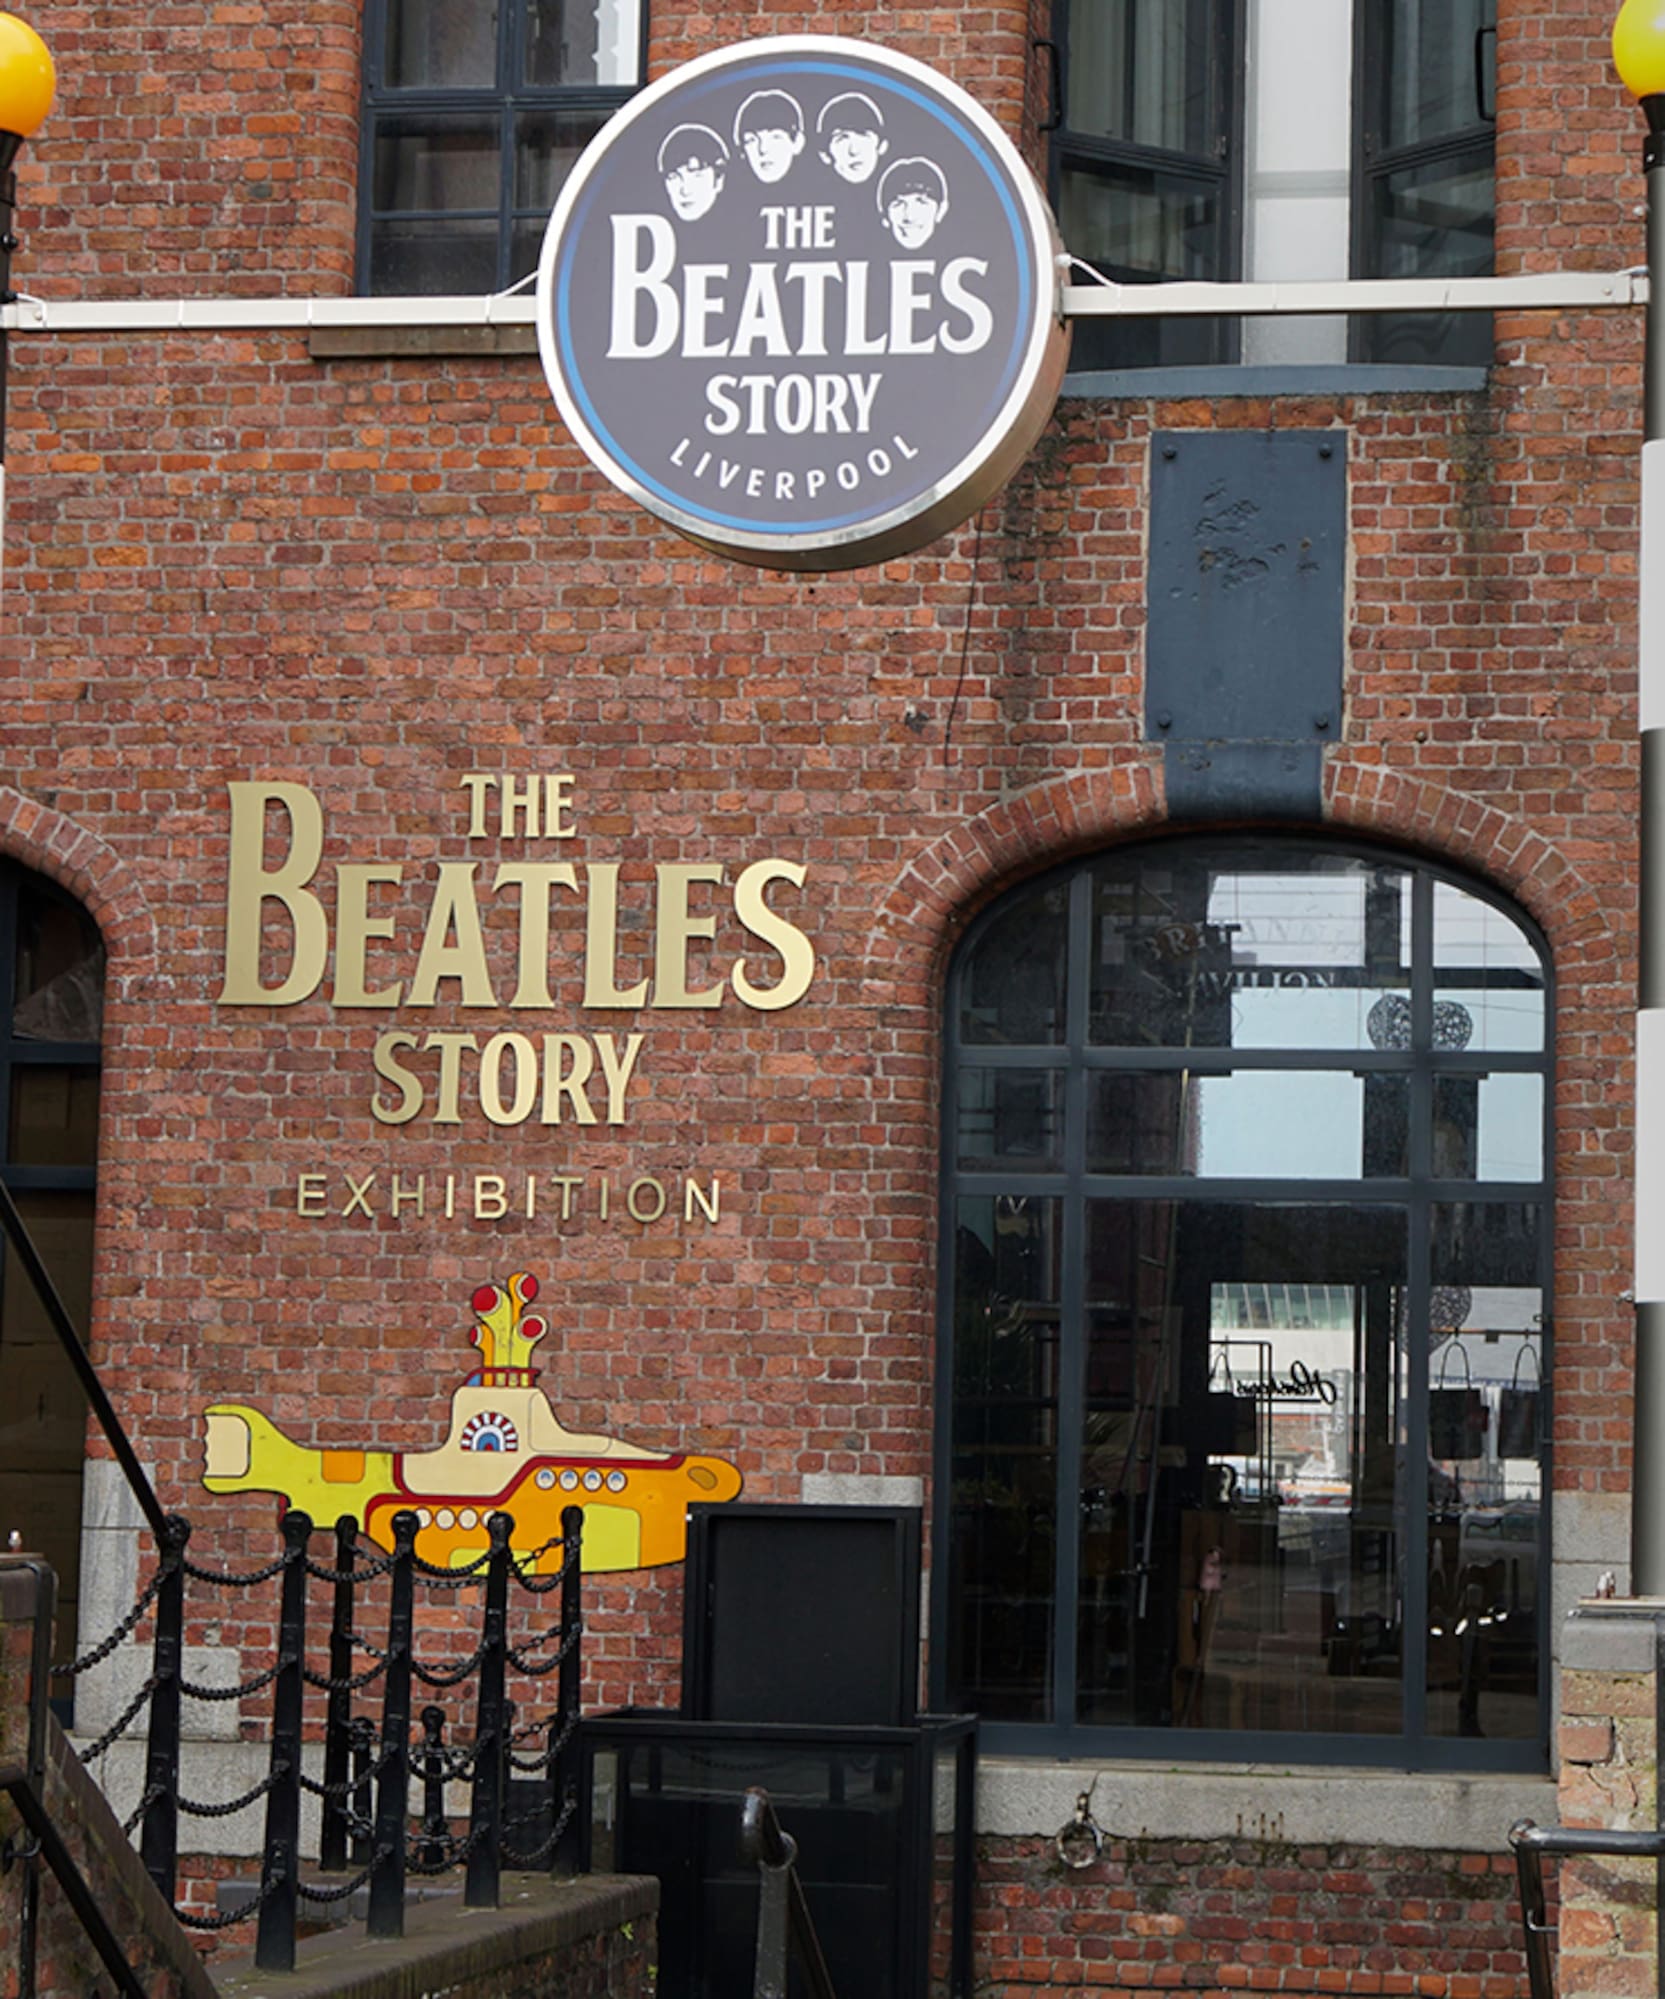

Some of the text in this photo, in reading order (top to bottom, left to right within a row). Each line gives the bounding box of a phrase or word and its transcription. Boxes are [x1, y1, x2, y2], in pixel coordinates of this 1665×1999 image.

[760, 205, 836, 249] THE
[606, 213, 993, 359] BEATLES
[705, 373, 882, 434] STORY
[669, 434, 918, 498] LIVERPOOL
[460, 774, 577, 839] THE
[216, 780, 816, 1010] BEATLES
[370, 1032, 645, 1126] STORY
[296, 1173, 721, 1224] EXHIBITION
